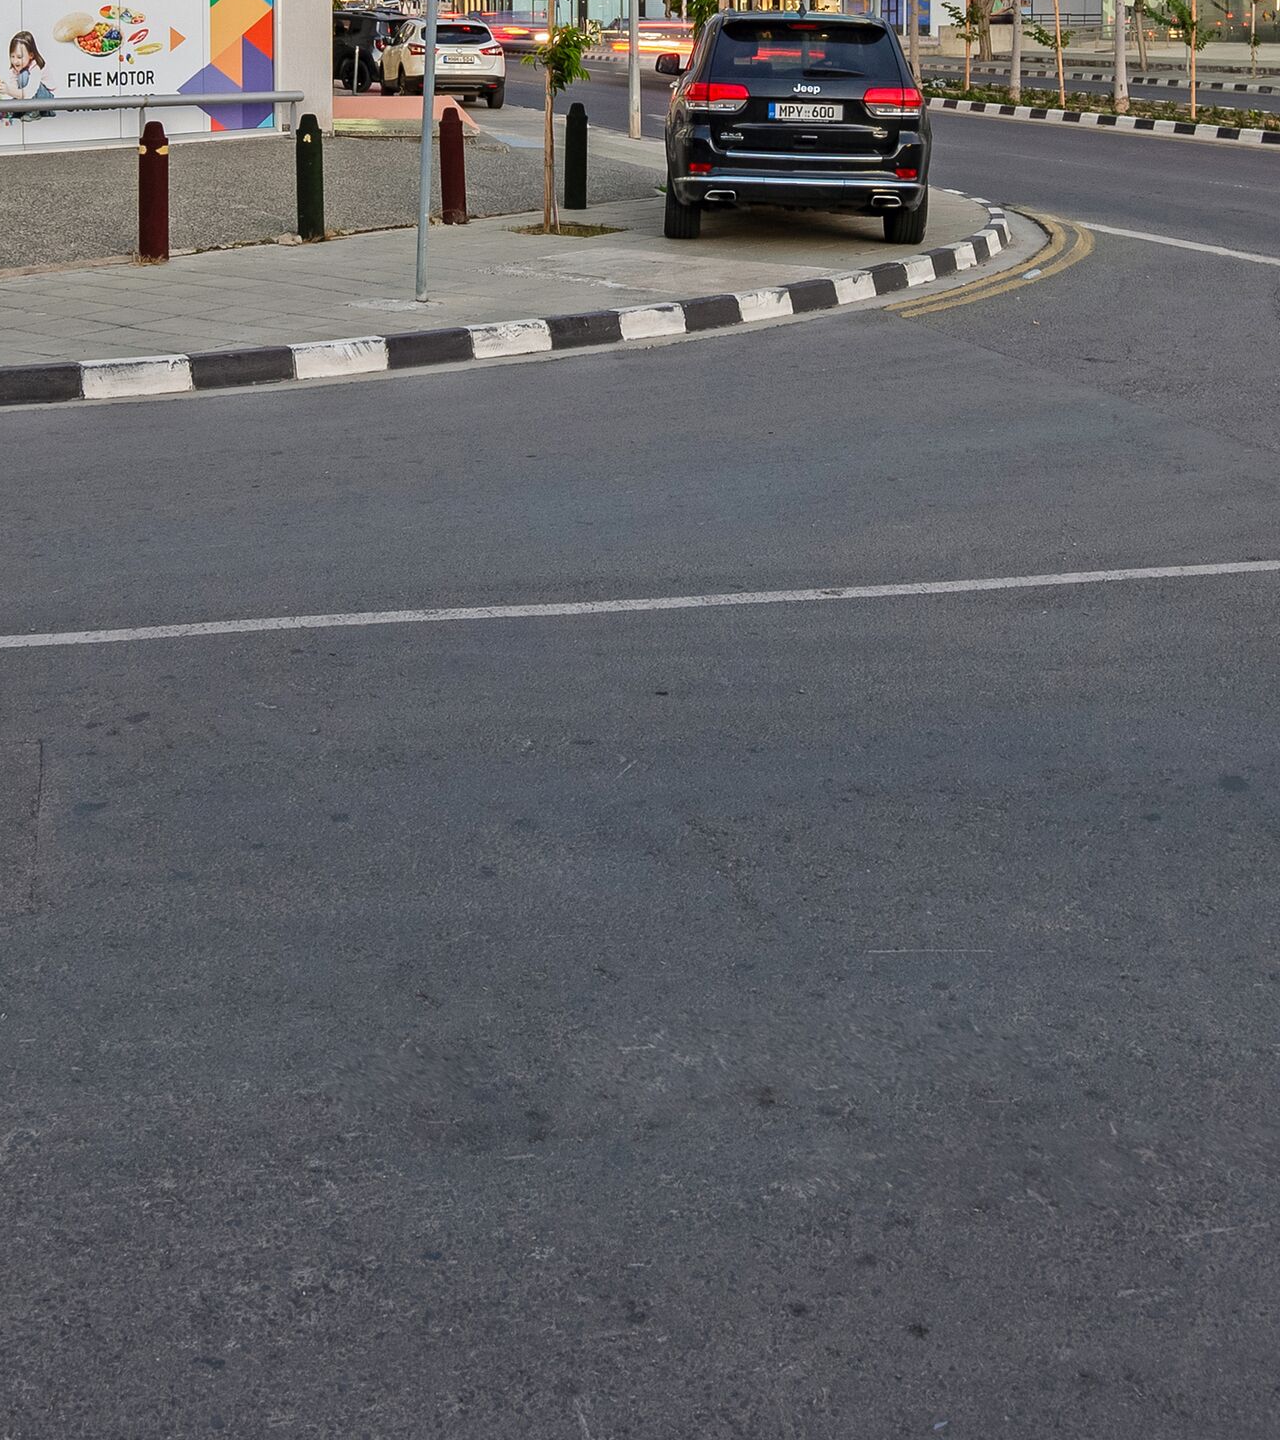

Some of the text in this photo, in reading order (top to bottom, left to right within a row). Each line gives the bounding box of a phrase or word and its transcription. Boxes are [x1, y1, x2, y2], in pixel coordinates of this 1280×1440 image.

[67, 70, 155, 88] FINE MOTOR
[793, 83, 821, 95] Jeep
[779, 105, 835, 118] MPY 600
